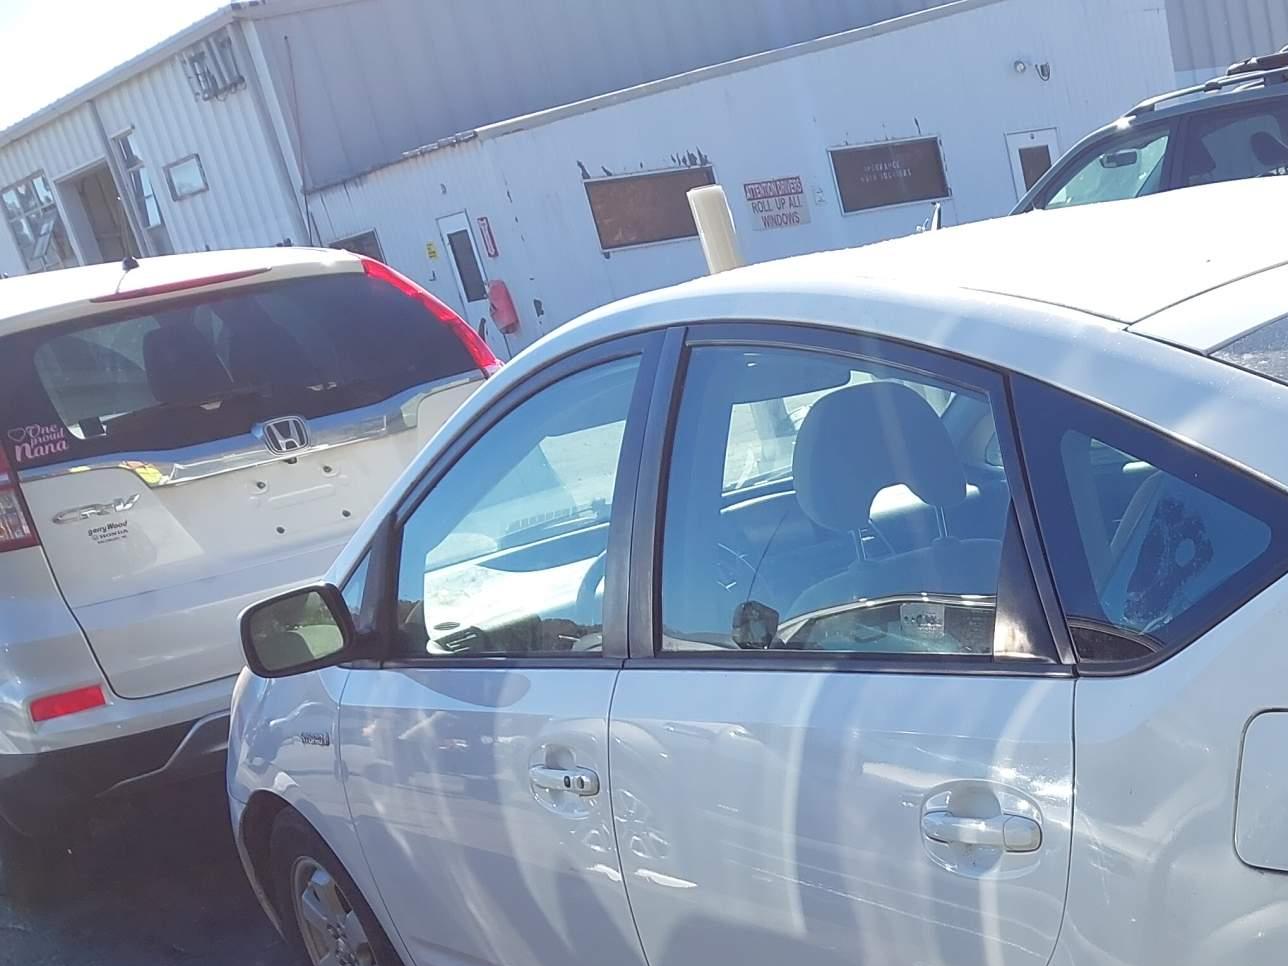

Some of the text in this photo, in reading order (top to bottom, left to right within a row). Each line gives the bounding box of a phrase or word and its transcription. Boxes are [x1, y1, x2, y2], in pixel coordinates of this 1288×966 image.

[751, 195, 804, 215] ROLL UP ALL
[761, 211, 801, 230] WINDOWS
[25, 423, 57, 438] One
